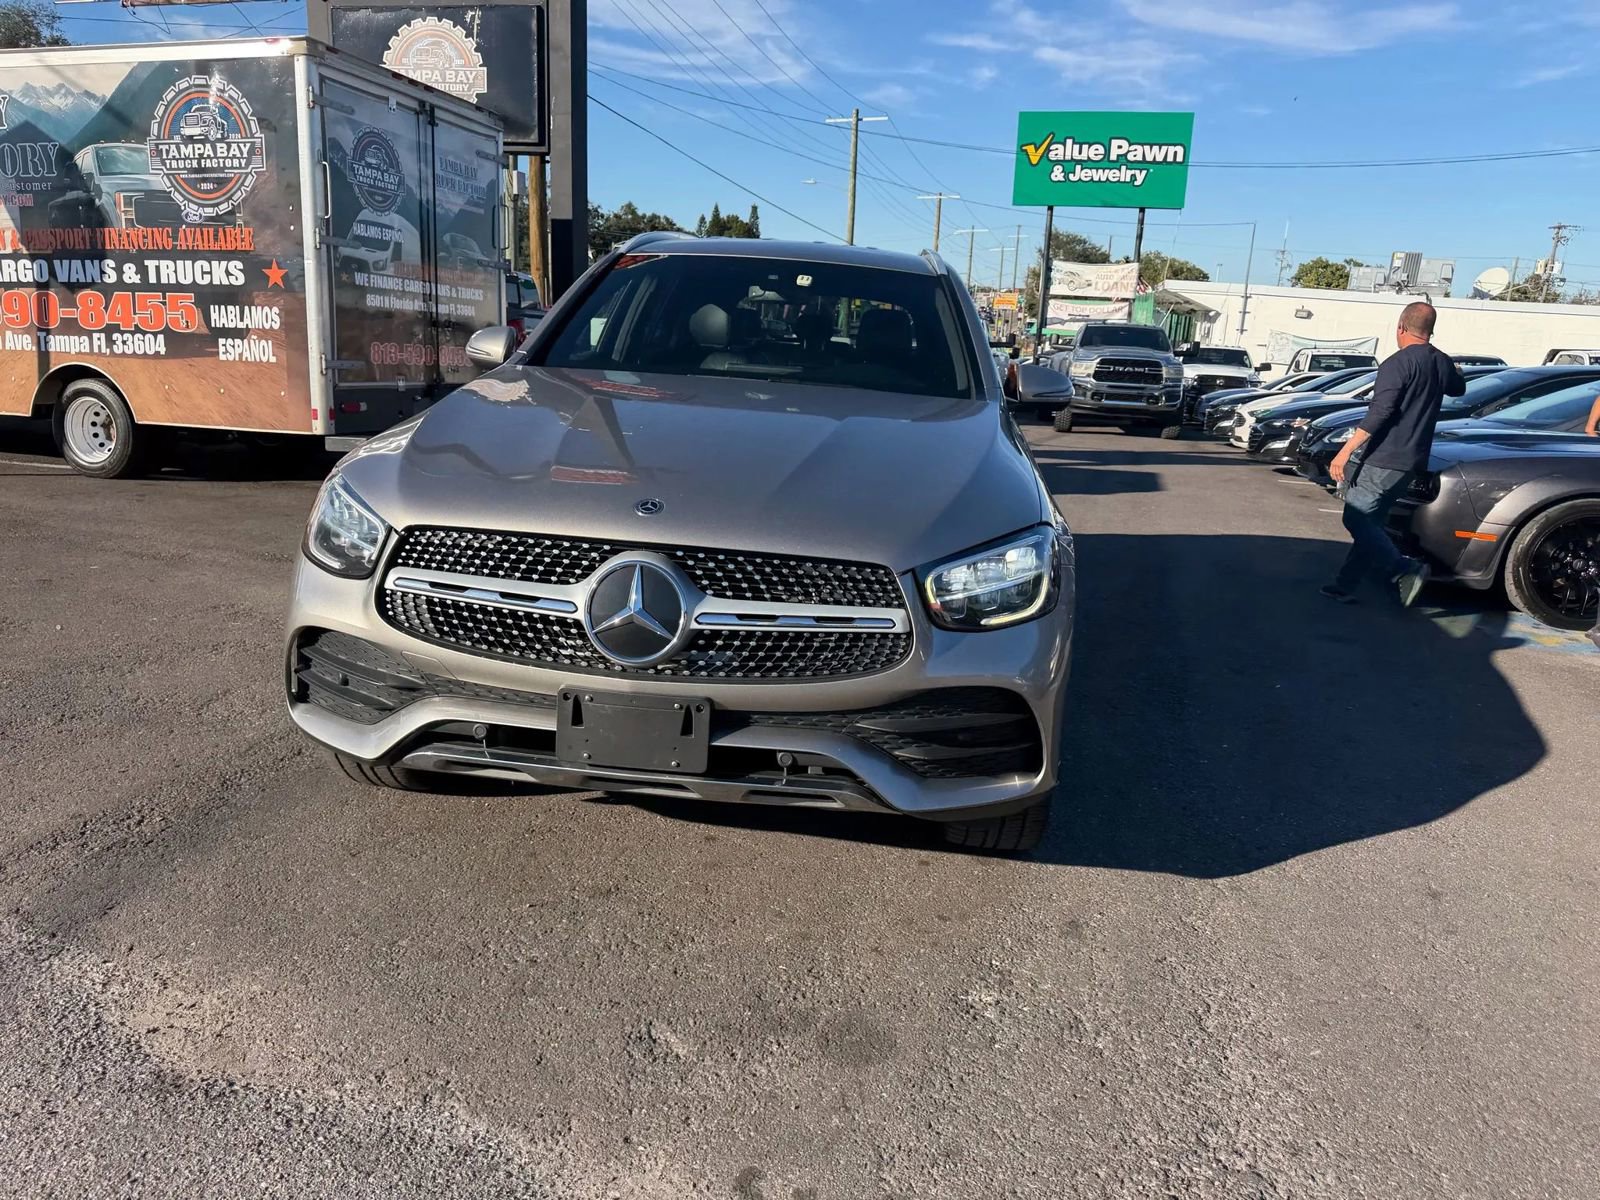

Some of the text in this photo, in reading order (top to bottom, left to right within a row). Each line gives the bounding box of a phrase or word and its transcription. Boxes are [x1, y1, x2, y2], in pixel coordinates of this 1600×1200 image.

[391, 68, 477, 83] AMPA BAY
[158, 142, 251, 159] TAMPA BAY
[1022, 133, 1185, 165] Value Pawn
[165, 158, 246, 169] TRUCK FACTORY
[353, 164, 400, 185] TAMPA BAY
[1050, 164, 1148, 186] & Jewelry
[25, 227, 92, 250] PASSPORT
[96, 227, 172, 251] FINANCING
[177, 227, 255, 251] AVAILABLE
[353, 222, 382, 240] HABLAMOS
[0, 259, 245, 286] RGO VANS & TRUCKS
[354, 271, 369, 286] WE
[370, 274, 403, 292] FINANCE
[404, 279, 431, 296] CARGO
[451, 288, 457, 298] &
[458, 286, 484, 302] TRUCKS
[0, 290, 198, 332] 90-8455
[366, 294, 384, 308] 8501
[390, 296, 413, 311] Florida
[1071, 304, 1087, 313] TOP
[210, 304, 280, 329] HABLAMOS
[5, 330, 36, 352] Ave.
[37, 331, 90, 354] Tampa
[113, 333, 166, 355] 33604
[218, 334, 276, 363] ESPAÑOL
[1115, 365, 1145, 373] RAM
